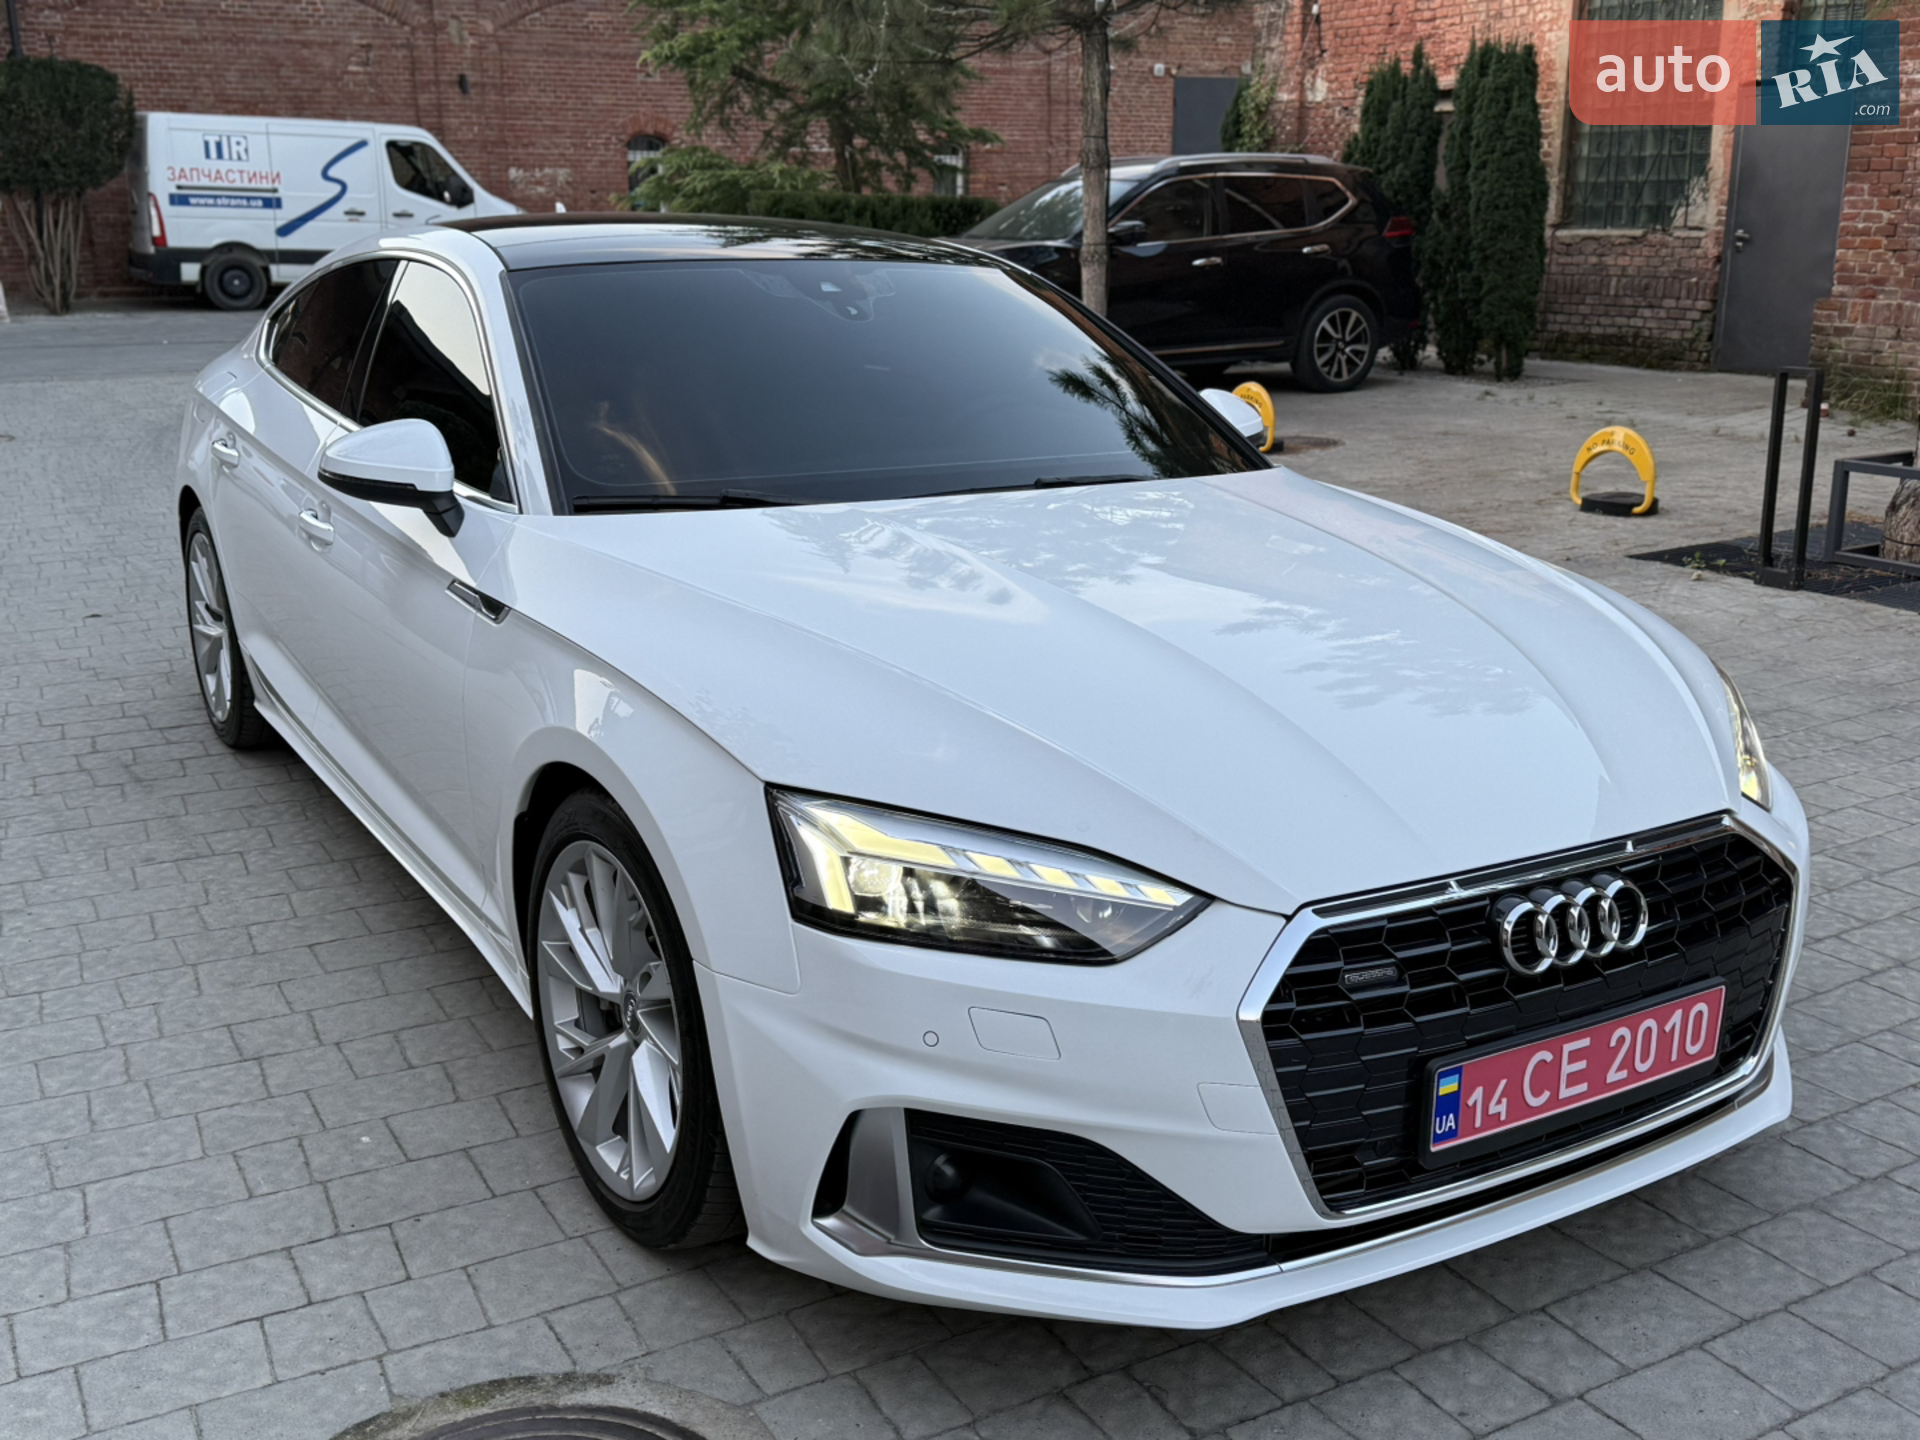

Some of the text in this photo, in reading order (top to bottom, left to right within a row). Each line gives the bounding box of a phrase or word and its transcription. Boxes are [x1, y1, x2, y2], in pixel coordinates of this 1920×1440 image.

[204, 134, 249, 161] TIR
[167, 167, 282, 186] ЗАПЧАСТИНИ
[1586, 438, 1636, 456] NO PARKING
[1466, 1001, 1710, 1130] 14 CE 2010
[1435, 1112, 1456, 1135] UA
